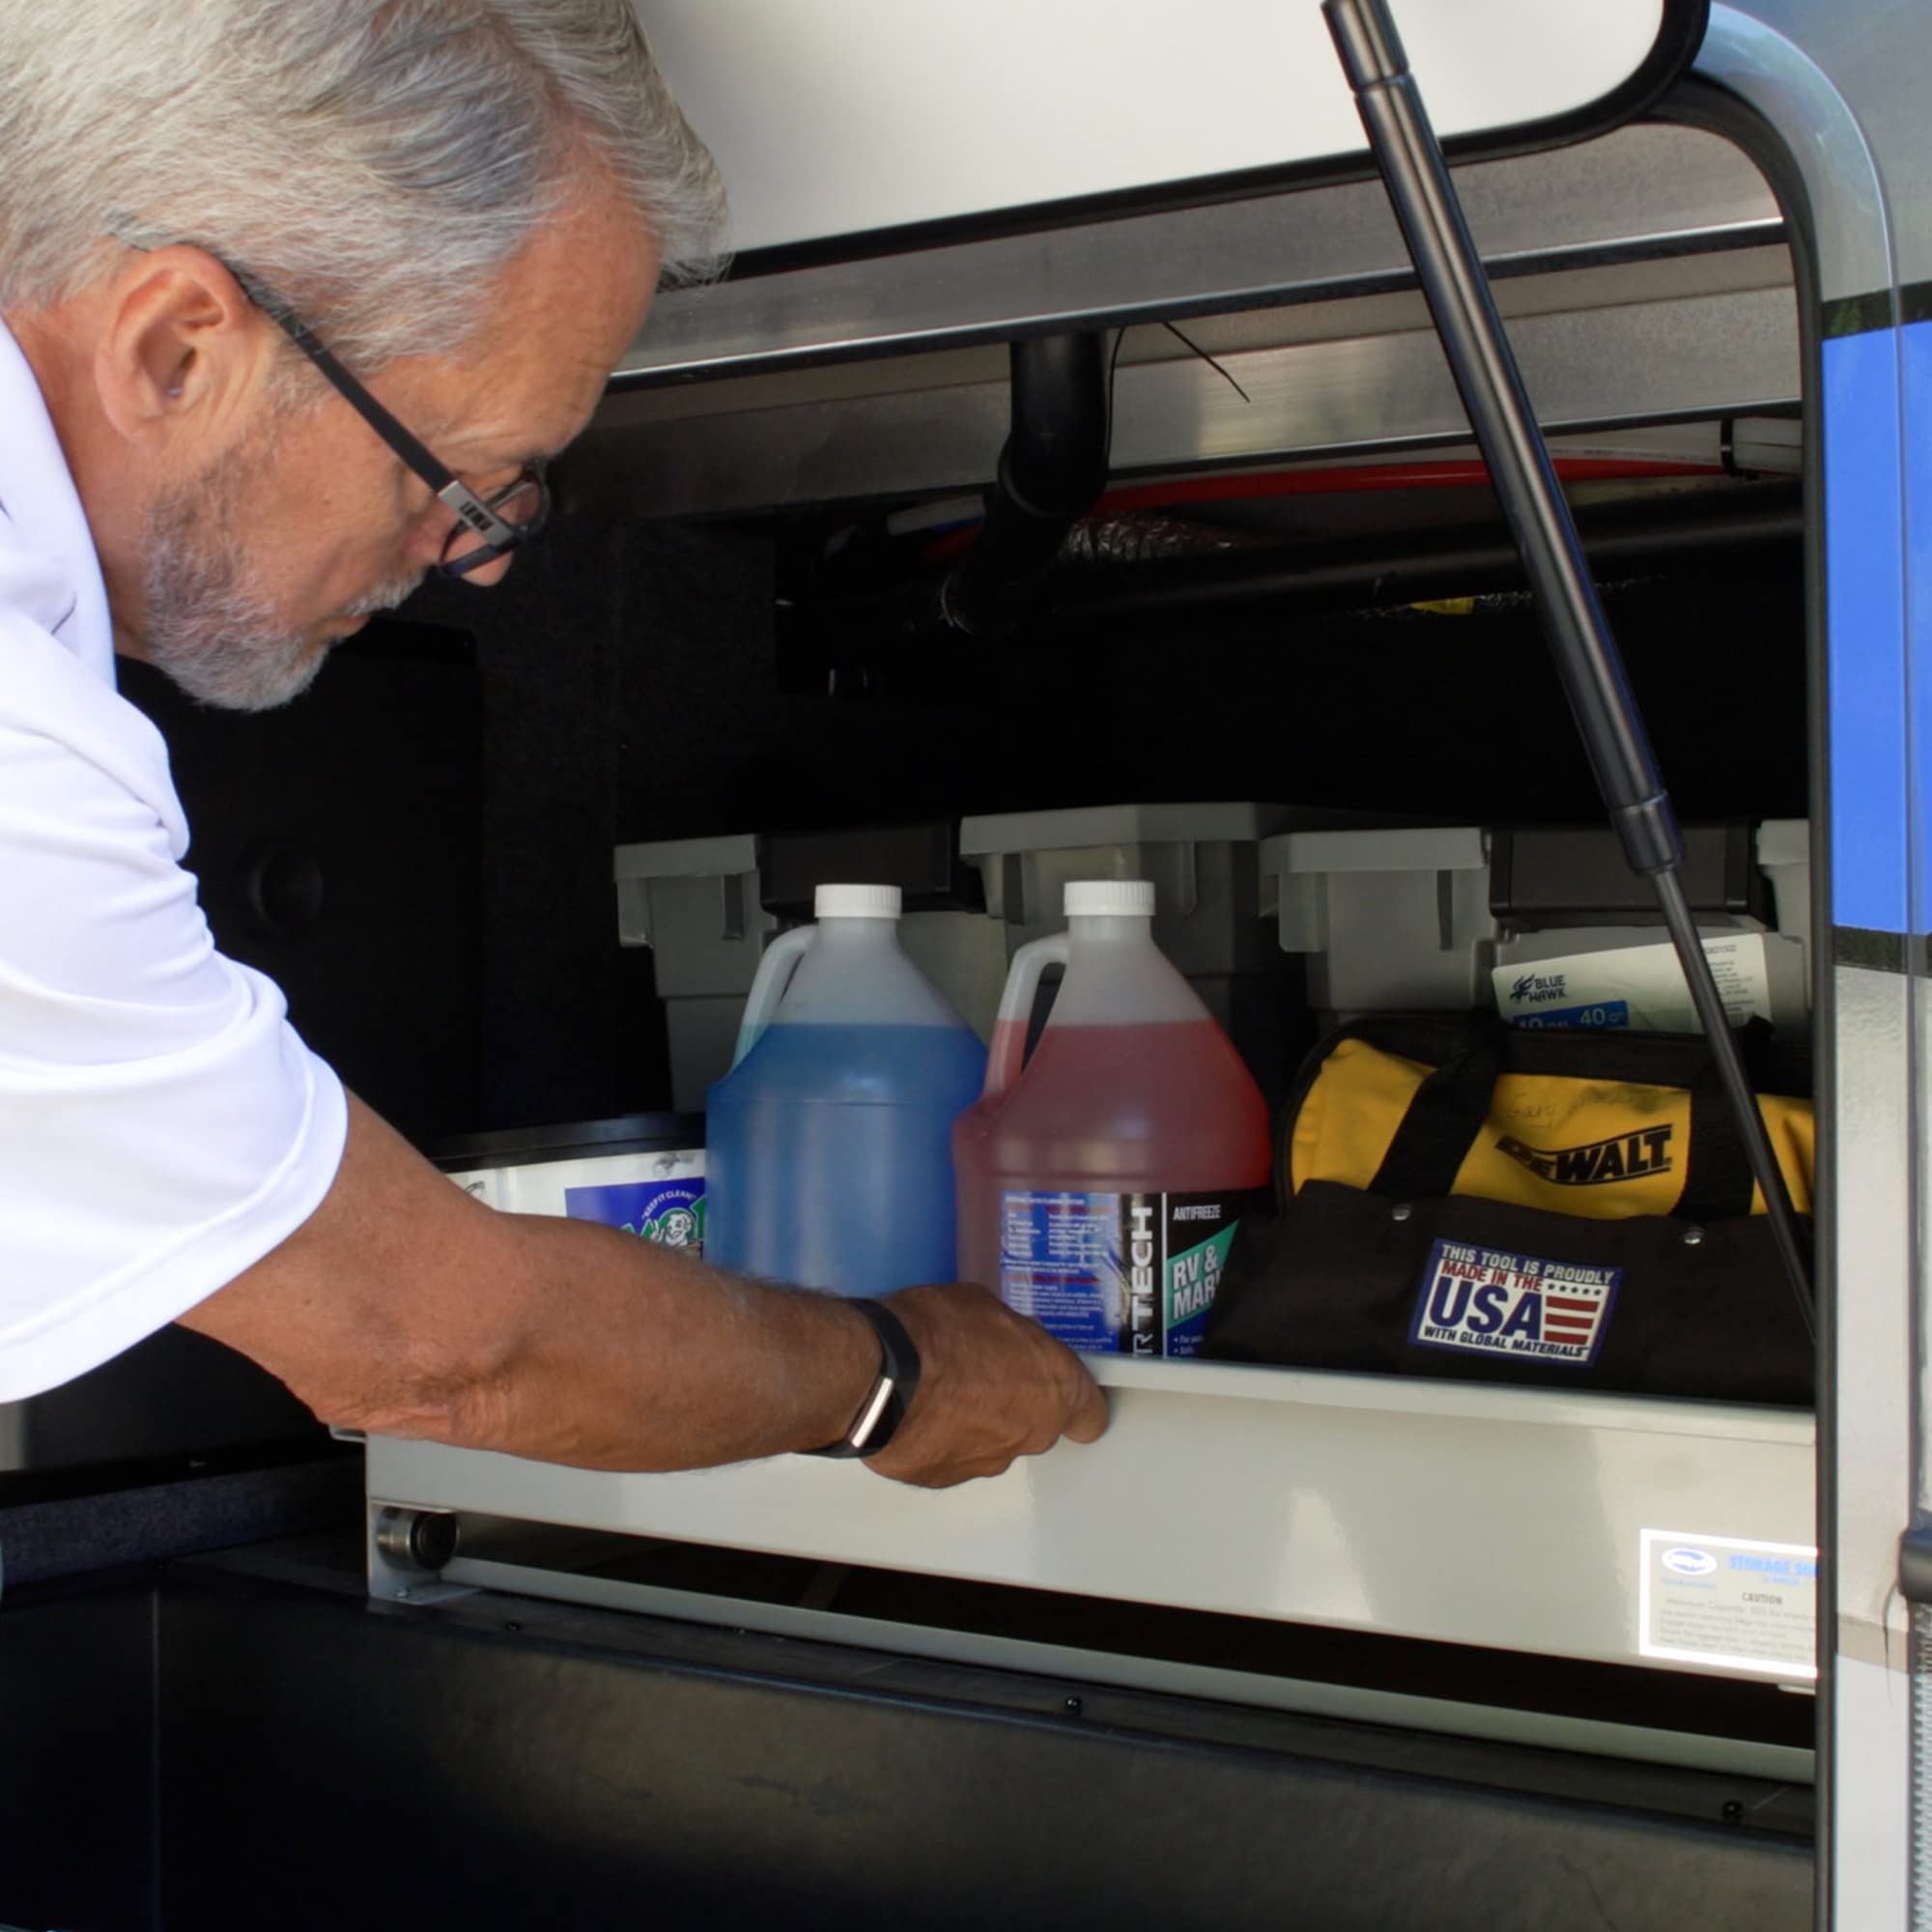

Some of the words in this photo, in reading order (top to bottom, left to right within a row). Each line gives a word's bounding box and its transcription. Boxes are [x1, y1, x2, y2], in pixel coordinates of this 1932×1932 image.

[1534, 974, 1565, 989] BLUE
[1528, 987, 1566, 1003] HAWK
[1579, 1008, 1605, 1025] 40
[1173, 1205, 1221, 1221] ANTIFREEZE
[1173, 1254, 1200, 1291] RV
[1205, 1245, 1218, 1273] &
[1442, 1244, 1477, 1263] THIS
[1482, 1252, 1518, 1271] TOOL
[1523, 1260, 1539, 1275] IS
[1544, 1264, 1614, 1285] PROUDLY
[1440, 1261, 1486, 1283] MADE
[1491, 1269, 1507, 1285] IN
[1512, 1274, 1544, 1292] THE
[1429, 1277, 1543, 1341] USA
[1424, 1325, 1457, 1342] WITH
[1460, 1331, 1506, 1350] GLOBAL
[1742, 1592, 1782, 1605] CAUTION
